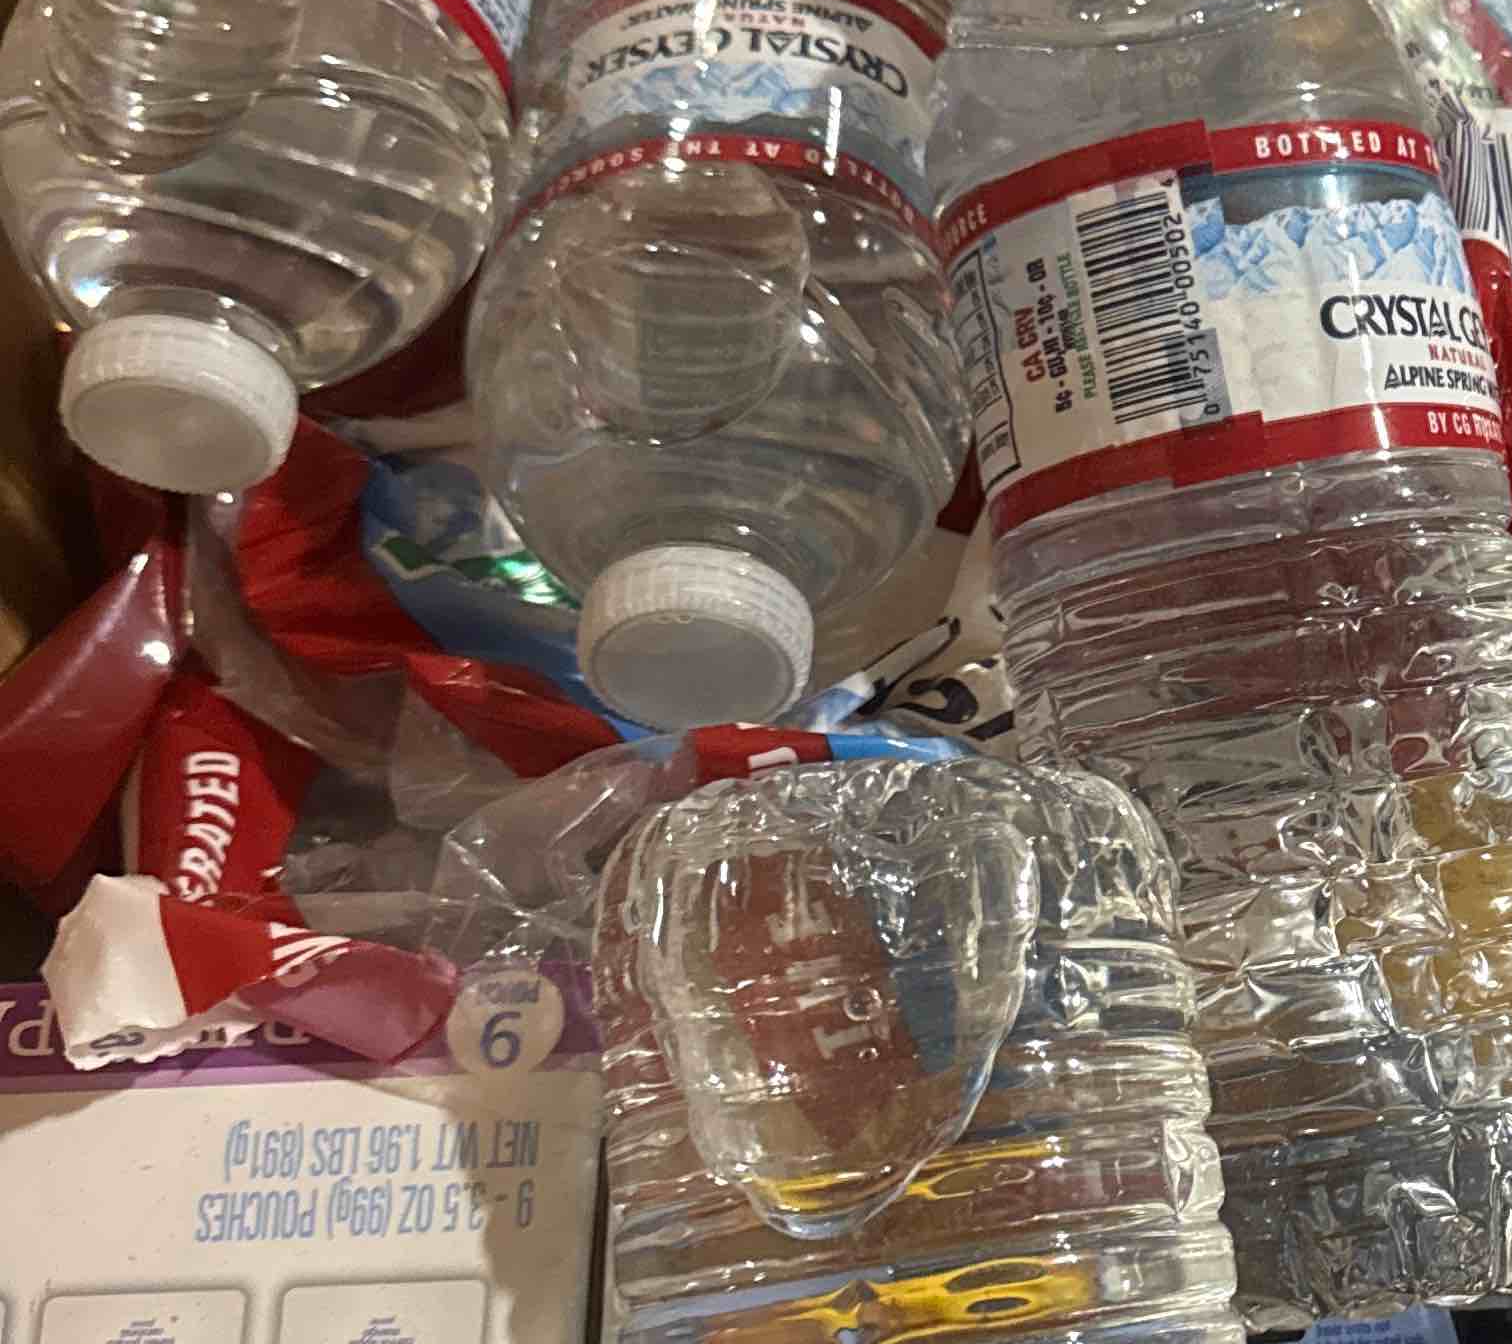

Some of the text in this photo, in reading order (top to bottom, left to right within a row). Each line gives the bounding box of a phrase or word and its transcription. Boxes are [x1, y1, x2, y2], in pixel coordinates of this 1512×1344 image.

[740, 26, 909, 98] CRYSTAL
[744, 142, 783, 159] AT
[1397, 136, 1417, 159] AT
[1162, 212, 1195, 289] 00502
[1014, 307, 1046, 383] CA CRV
[1180, 301, 1212, 379] 75140
[1320, 294, 1462, 341] CRYSTAL
[1384, 364, 1446, 390] ALPINE
[1427, 410, 1471, 436] BY CG
[224, 1120, 540, 1183] NET WT 1.96 LBS (891g)
[194, 1180, 535, 1242] 9 3.5 OZ (99g) POUCHES
